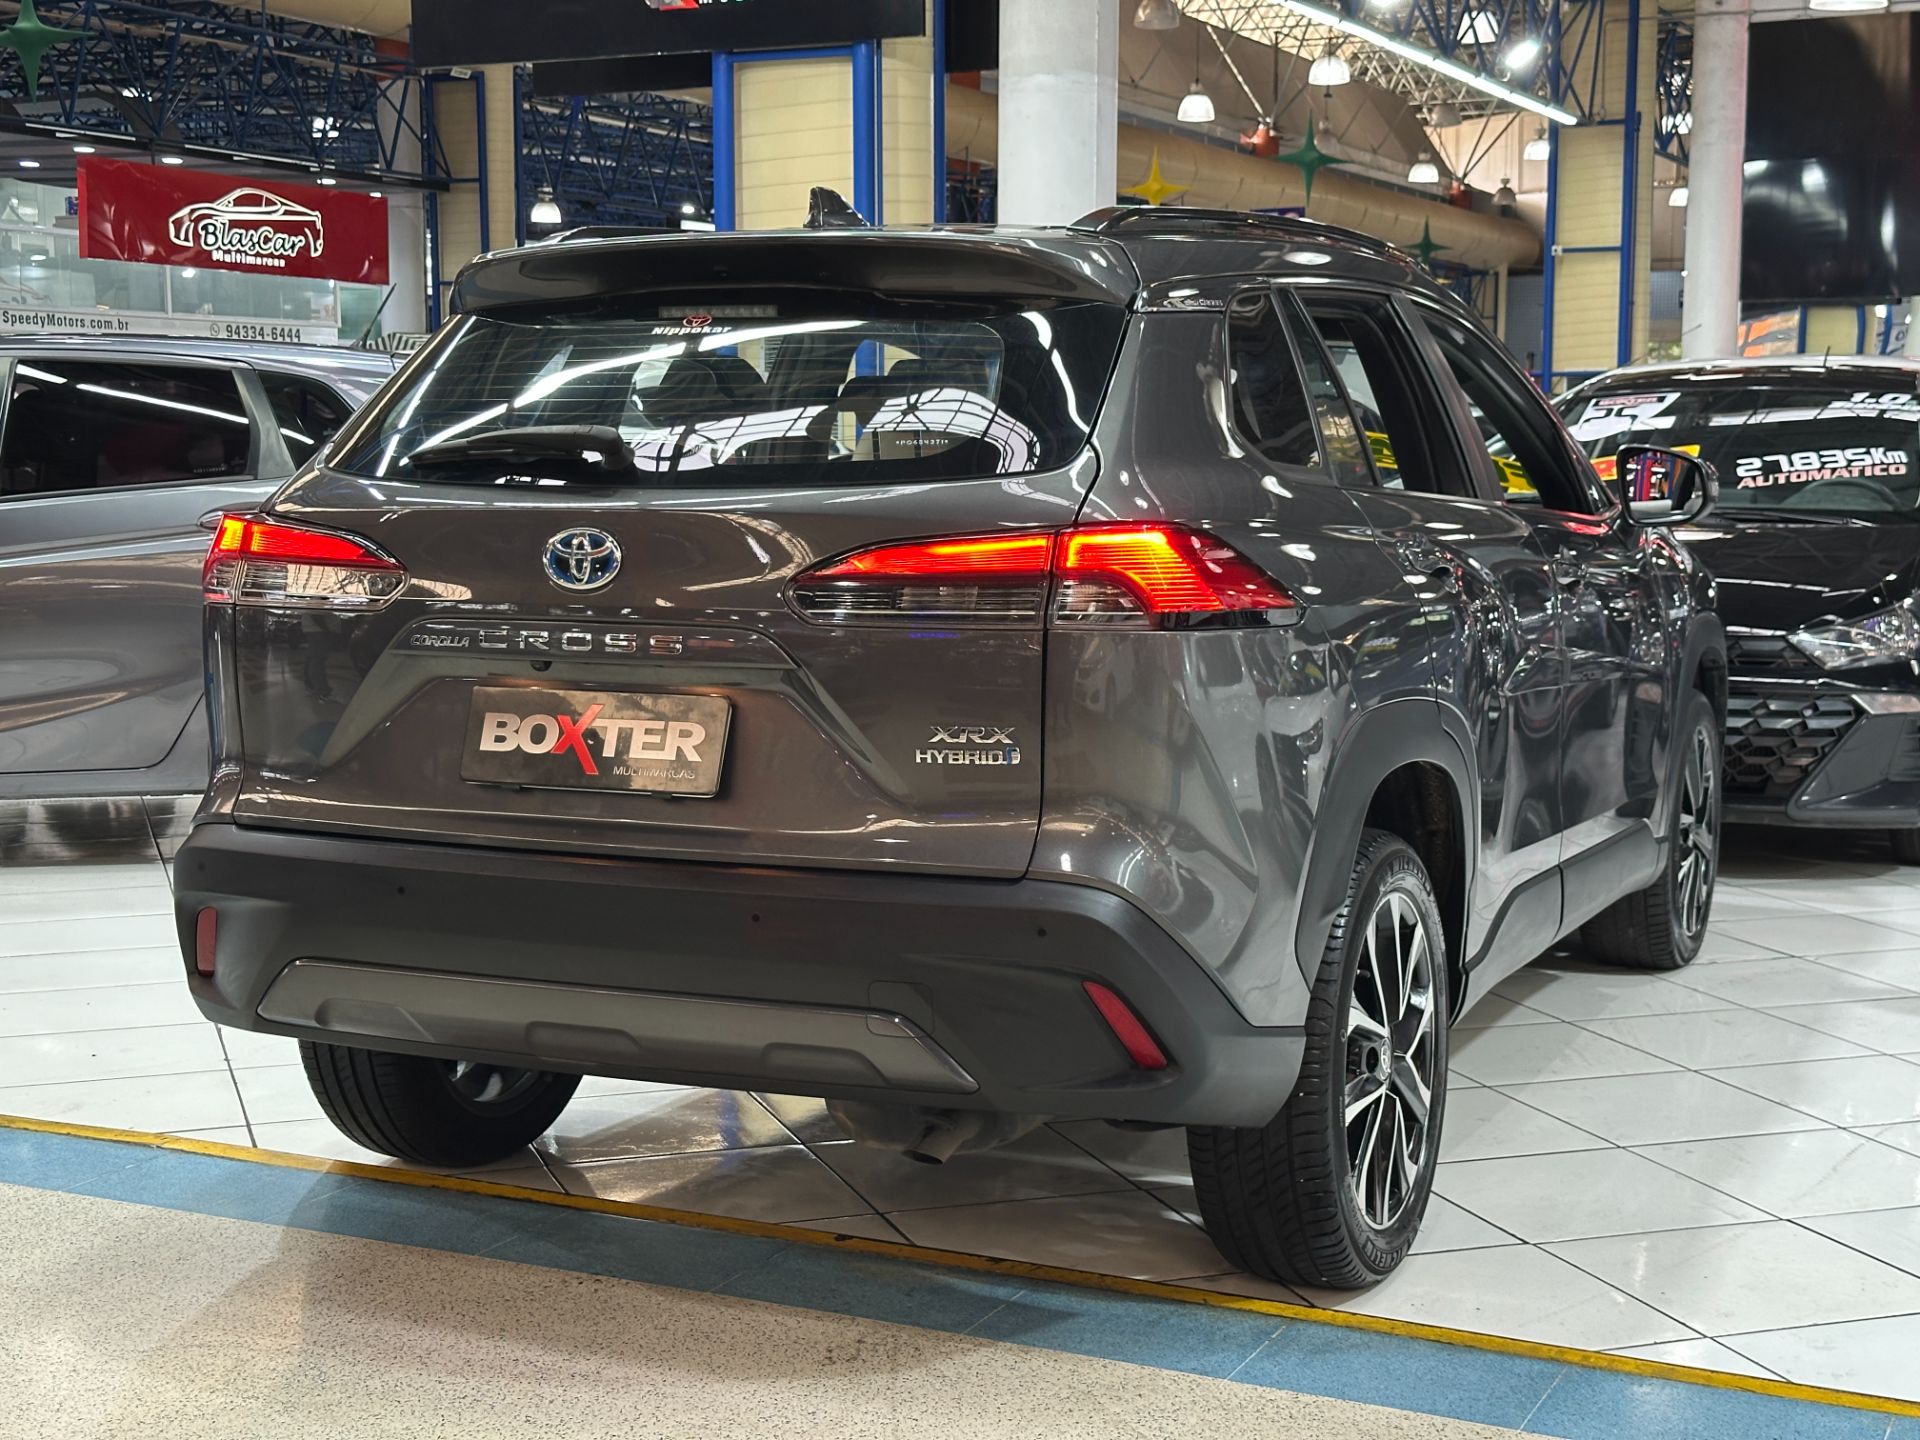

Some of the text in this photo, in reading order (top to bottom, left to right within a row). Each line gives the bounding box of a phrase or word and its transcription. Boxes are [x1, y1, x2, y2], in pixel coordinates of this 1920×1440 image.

[199, 220, 305, 257] BlasCar
[212, 250, 286, 268] Multimarcas
[2, 310, 129, 331] SpeedyMotors.com.br
[226, 324, 301, 342] 94334-6444
[1737, 464, 1907, 490] AUTOMATICO
[410, 629, 683, 655] COROLLA CROSS
[479, 704, 706, 775] BOXTER
[928, 726, 1016, 744] XRX
[915, 749, 1004, 765] HYBRID
